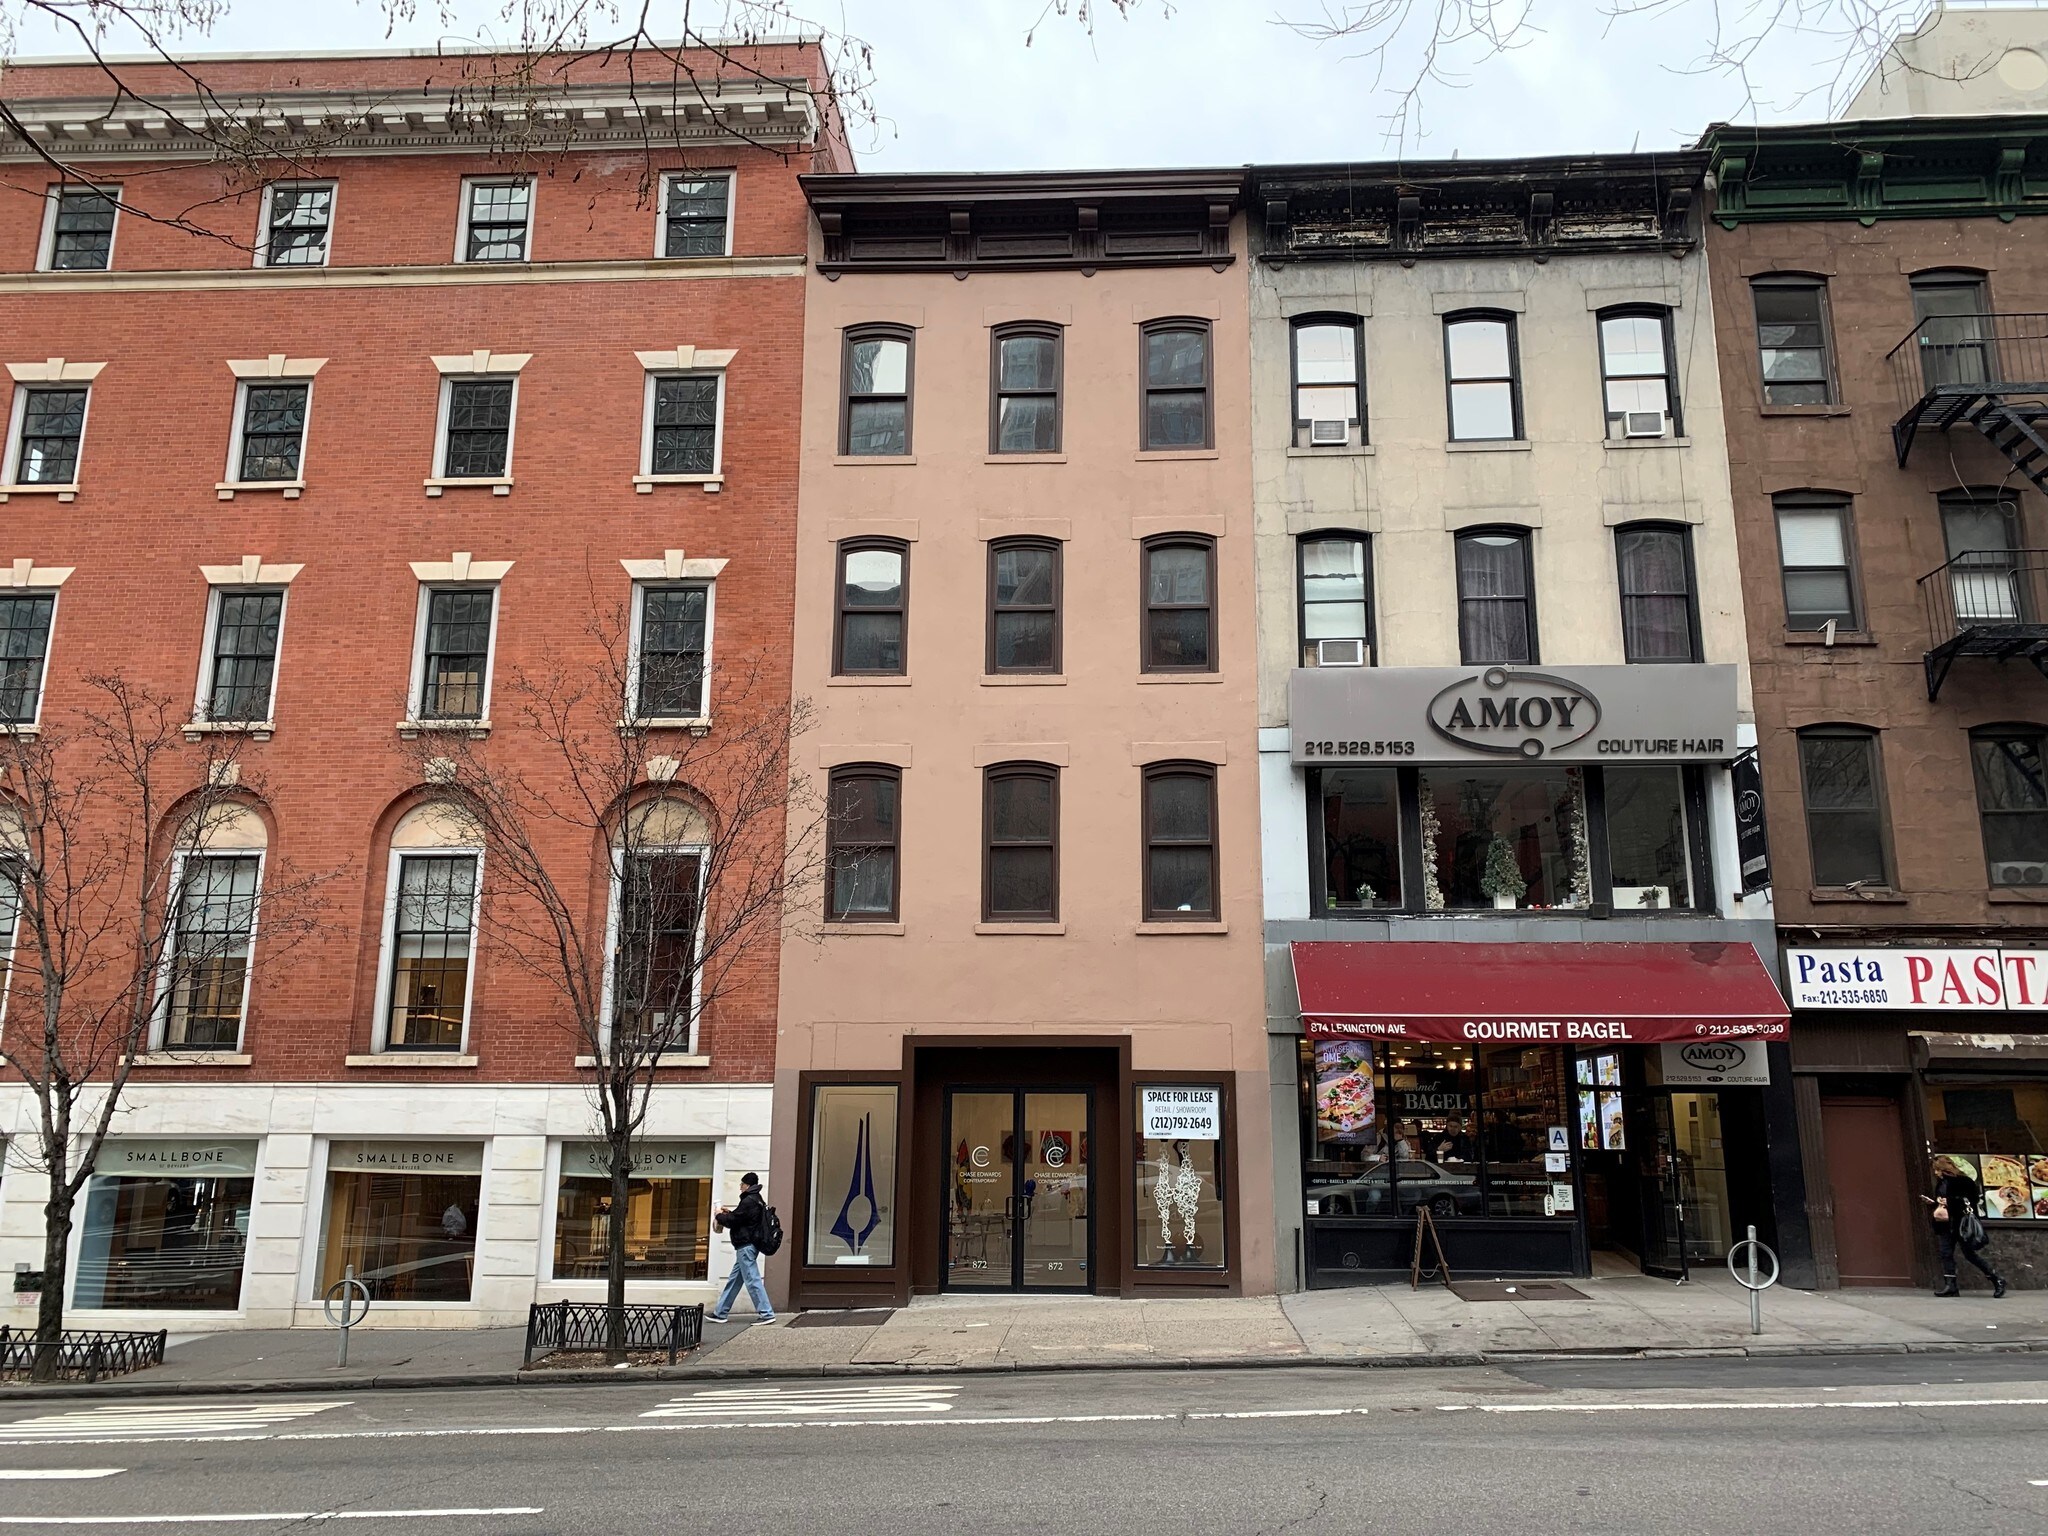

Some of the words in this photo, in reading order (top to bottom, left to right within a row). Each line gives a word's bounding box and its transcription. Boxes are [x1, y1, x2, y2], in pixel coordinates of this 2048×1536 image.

[1445, 697, 1583, 729] AMOY
[1305, 741, 1415, 756] 212.529.5153
[1597, 739, 1678, 754] COUTURE
[1682, 738, 1724, 753] HAIR
[1796, 954, 1884, 984] Pasta
[1904, 955, 2048, 1006] PAST
[1310, 1022, 1328, 1032] 874
[1331, 1023, 1385, 1033] LEXINGTON
[1387, 1024, 1406, 1034] AVE
[1463, 1022, 1561, 1039] GOURMET
[1567, 1022, 1632, 1039] BAGEL
[1709, 1024, 1784, 1035] 212-535-3030
[1687, 1048, 1736, 1060] AMOY
[1147, 1092, 1171, 1102] SPACE
[1173, 1092, 1188, 1102] FOR
[1190, 1092, 1213, 1102] LEASE
[1404, 1094, 1467, 1109] BAGEL
[1553, 1131, 1565, 1144] A
[127, 1151, 224, 1162] SMALLBONE
[357, 1153, 454, 1163] SMALLBONE
[589, 1154, 687, 1164] SMLBONE
[972, 1260, 987, 1269] 872
[1048, 1262, 1063, 1271] 872
